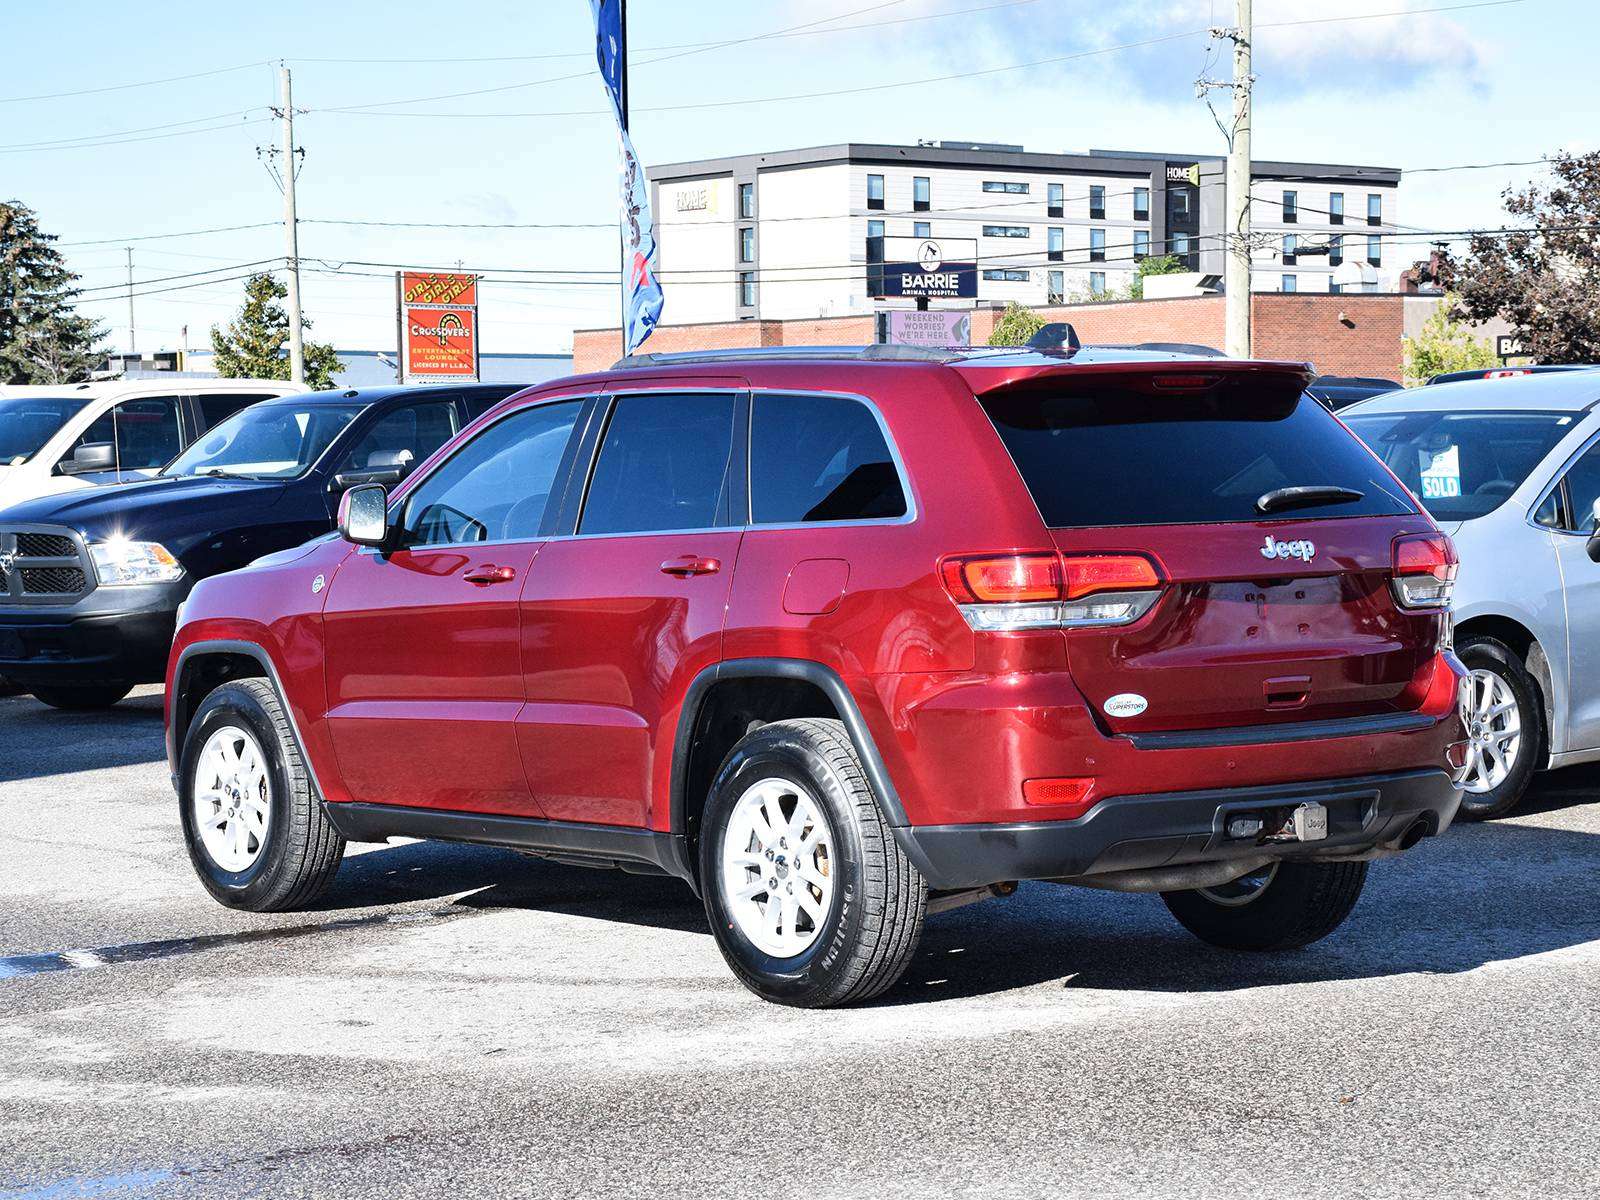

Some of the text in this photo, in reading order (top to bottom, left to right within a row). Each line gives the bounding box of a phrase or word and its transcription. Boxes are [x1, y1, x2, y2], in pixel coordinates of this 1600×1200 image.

[405, 273, 439, 302] GIRLS
[423, 273, 456, 303] GIRLS
[441, 274, 475, 304] GIRLS
[901, 273, 959, 289] BARRIE
[903, 322, 946, 331] WORRIES?
[904, 313, 945, 322] WEEKEND
[898, 330, 924, 339] WE'RE
[1423, 477, 1459, 497] SOLD
[1260, 534, 1316, 563] Jeep
